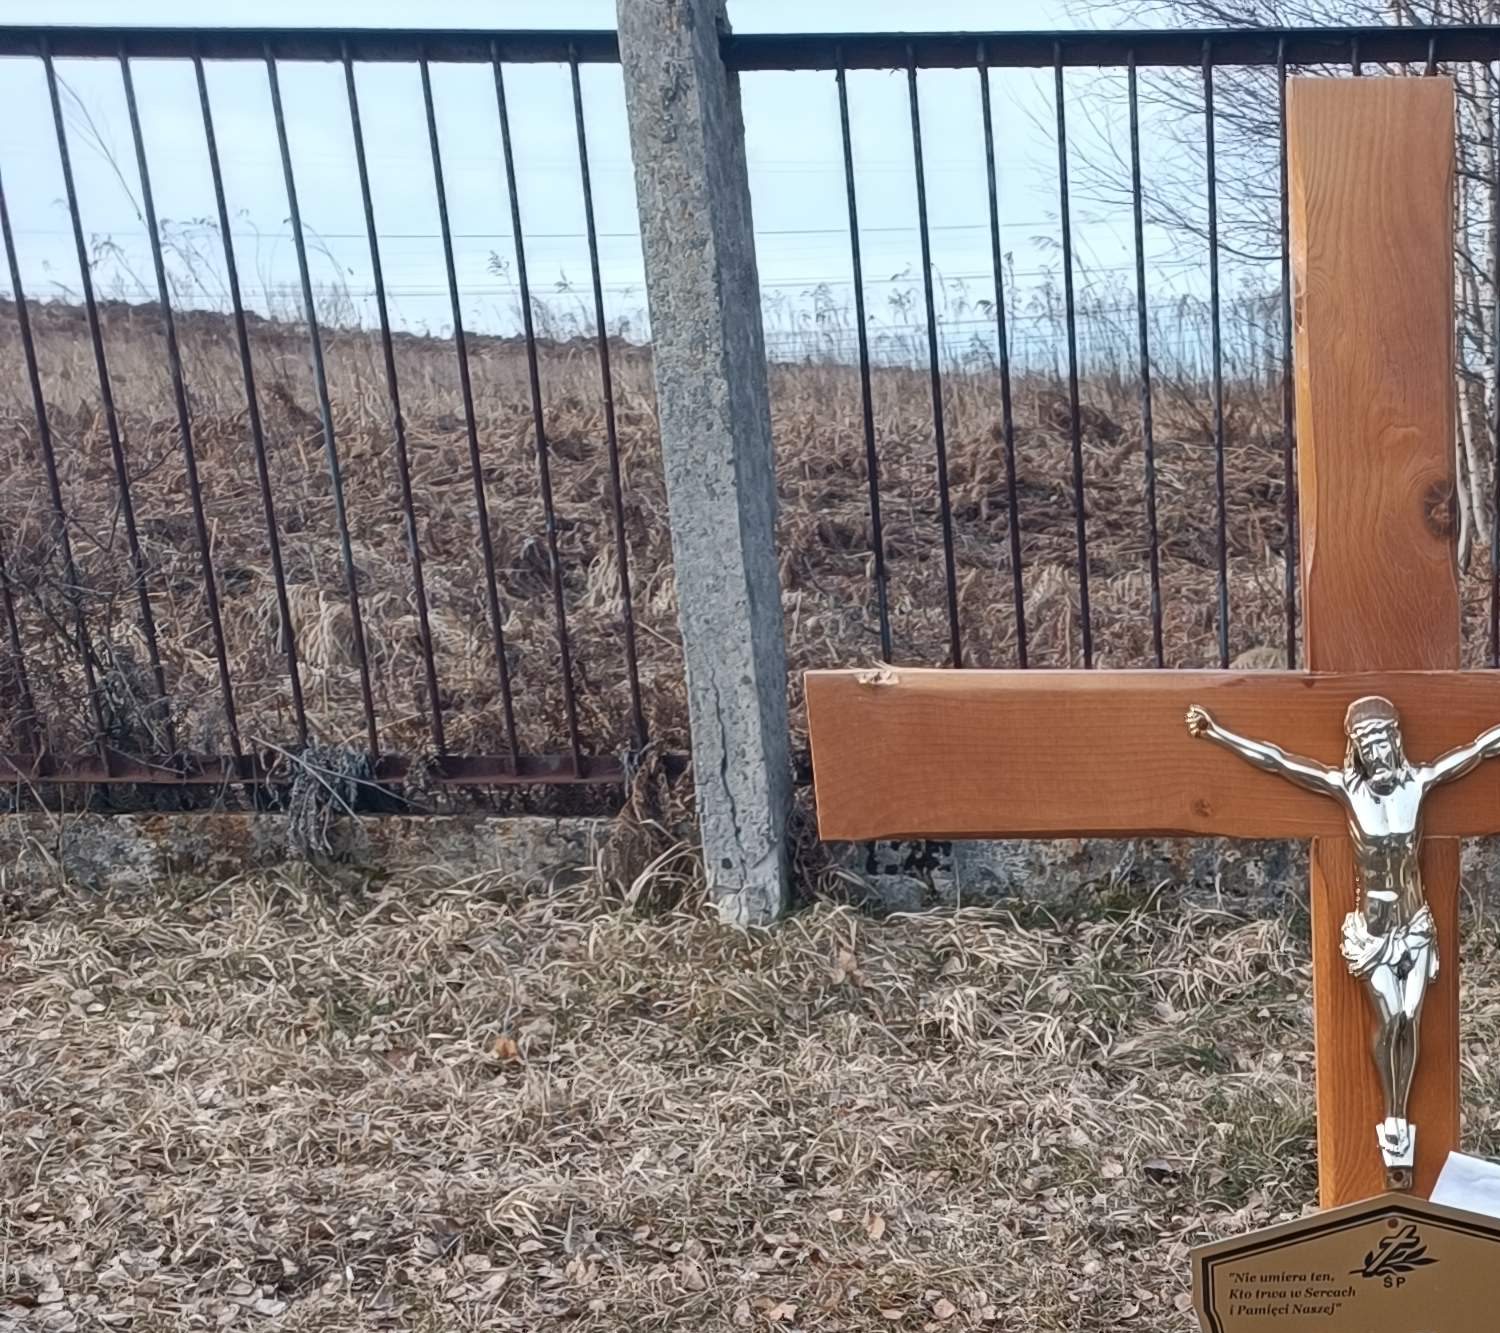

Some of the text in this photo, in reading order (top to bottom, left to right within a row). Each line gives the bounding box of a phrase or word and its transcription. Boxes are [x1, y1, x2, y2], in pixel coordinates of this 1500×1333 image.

[1260, 1271, 1306, 1283] umiera
[1229, 1286, 1356, 1300] Kto trwa w Sercach
[1237, 1303, 1290, 1317] Pamięci
